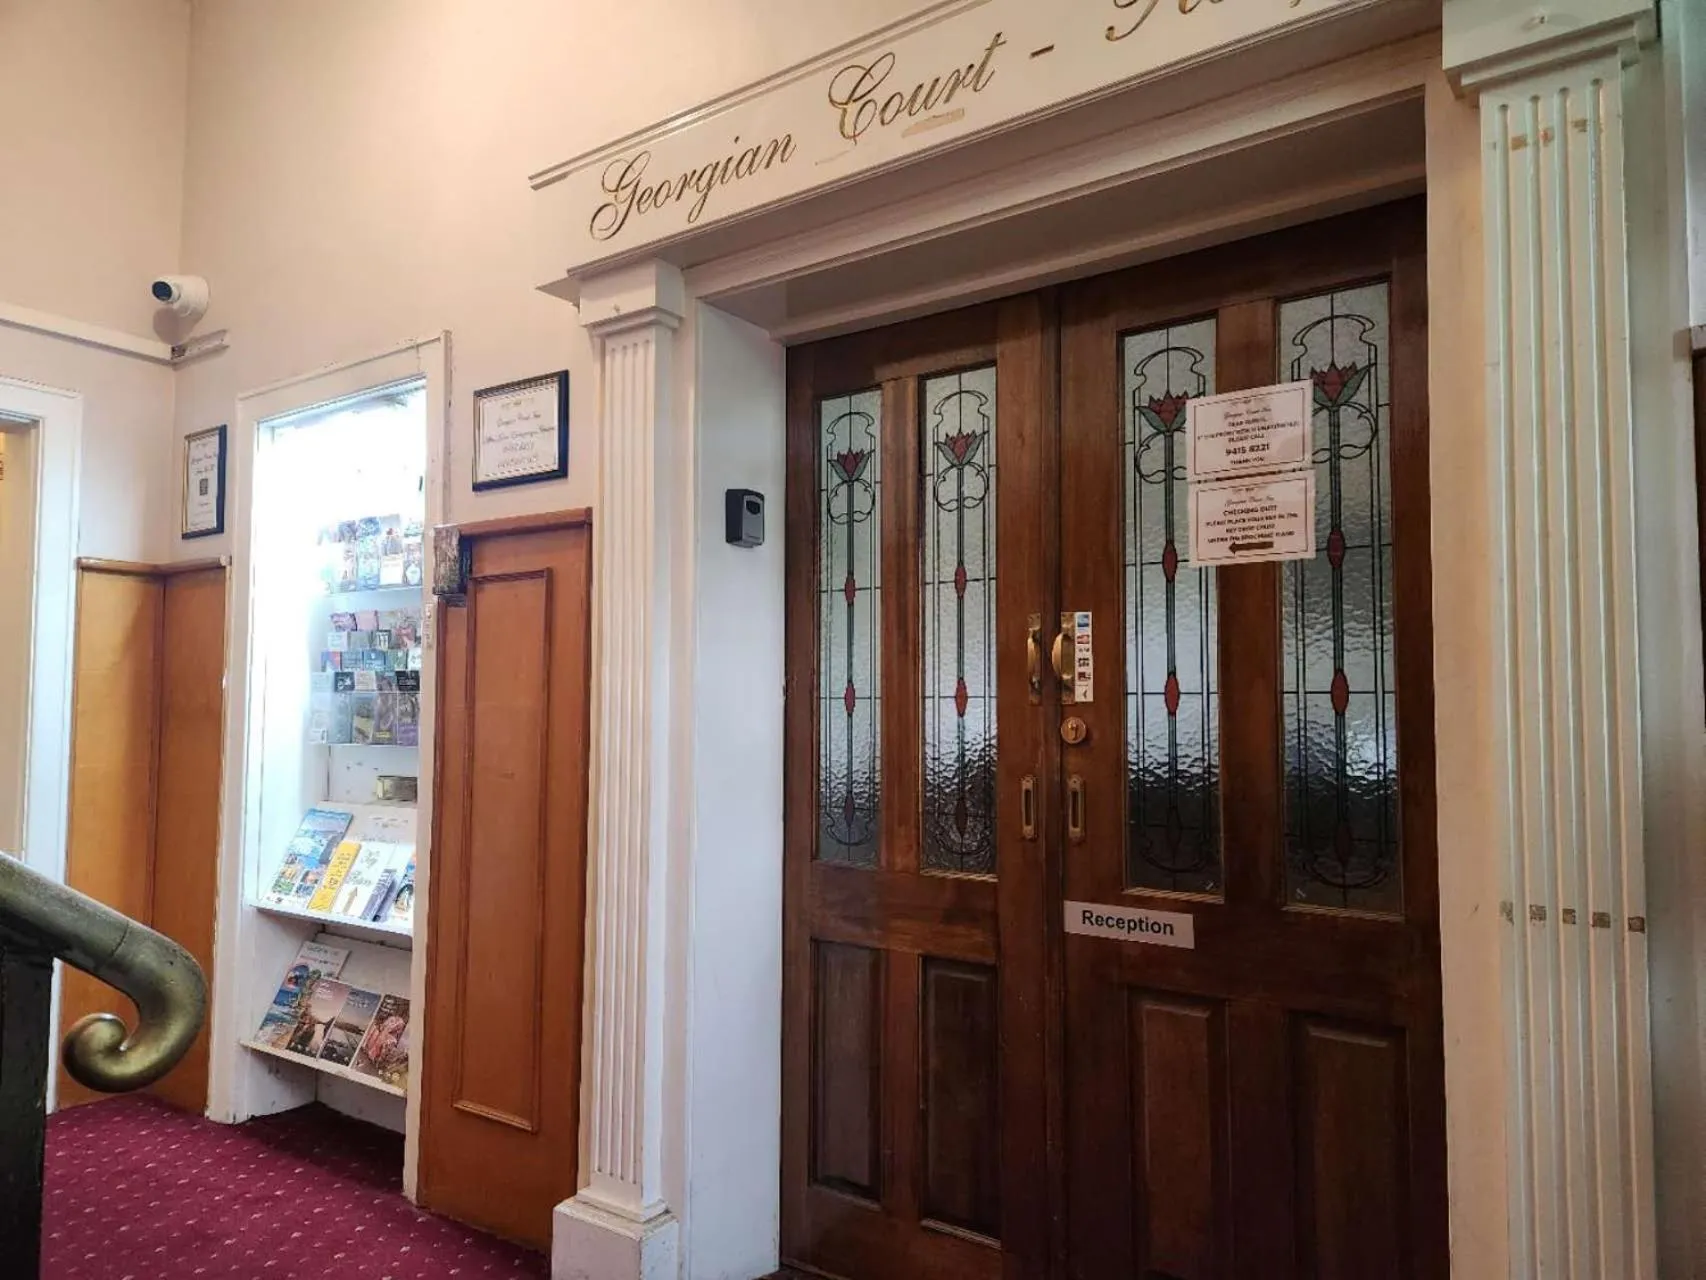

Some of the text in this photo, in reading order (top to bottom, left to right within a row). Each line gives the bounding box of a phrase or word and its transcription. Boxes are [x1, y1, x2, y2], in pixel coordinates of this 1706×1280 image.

[589, 133, 797, 241] Georgian
[828, 31, 1007, 145] Court
[1082, 909, 1175, 936] Reception
